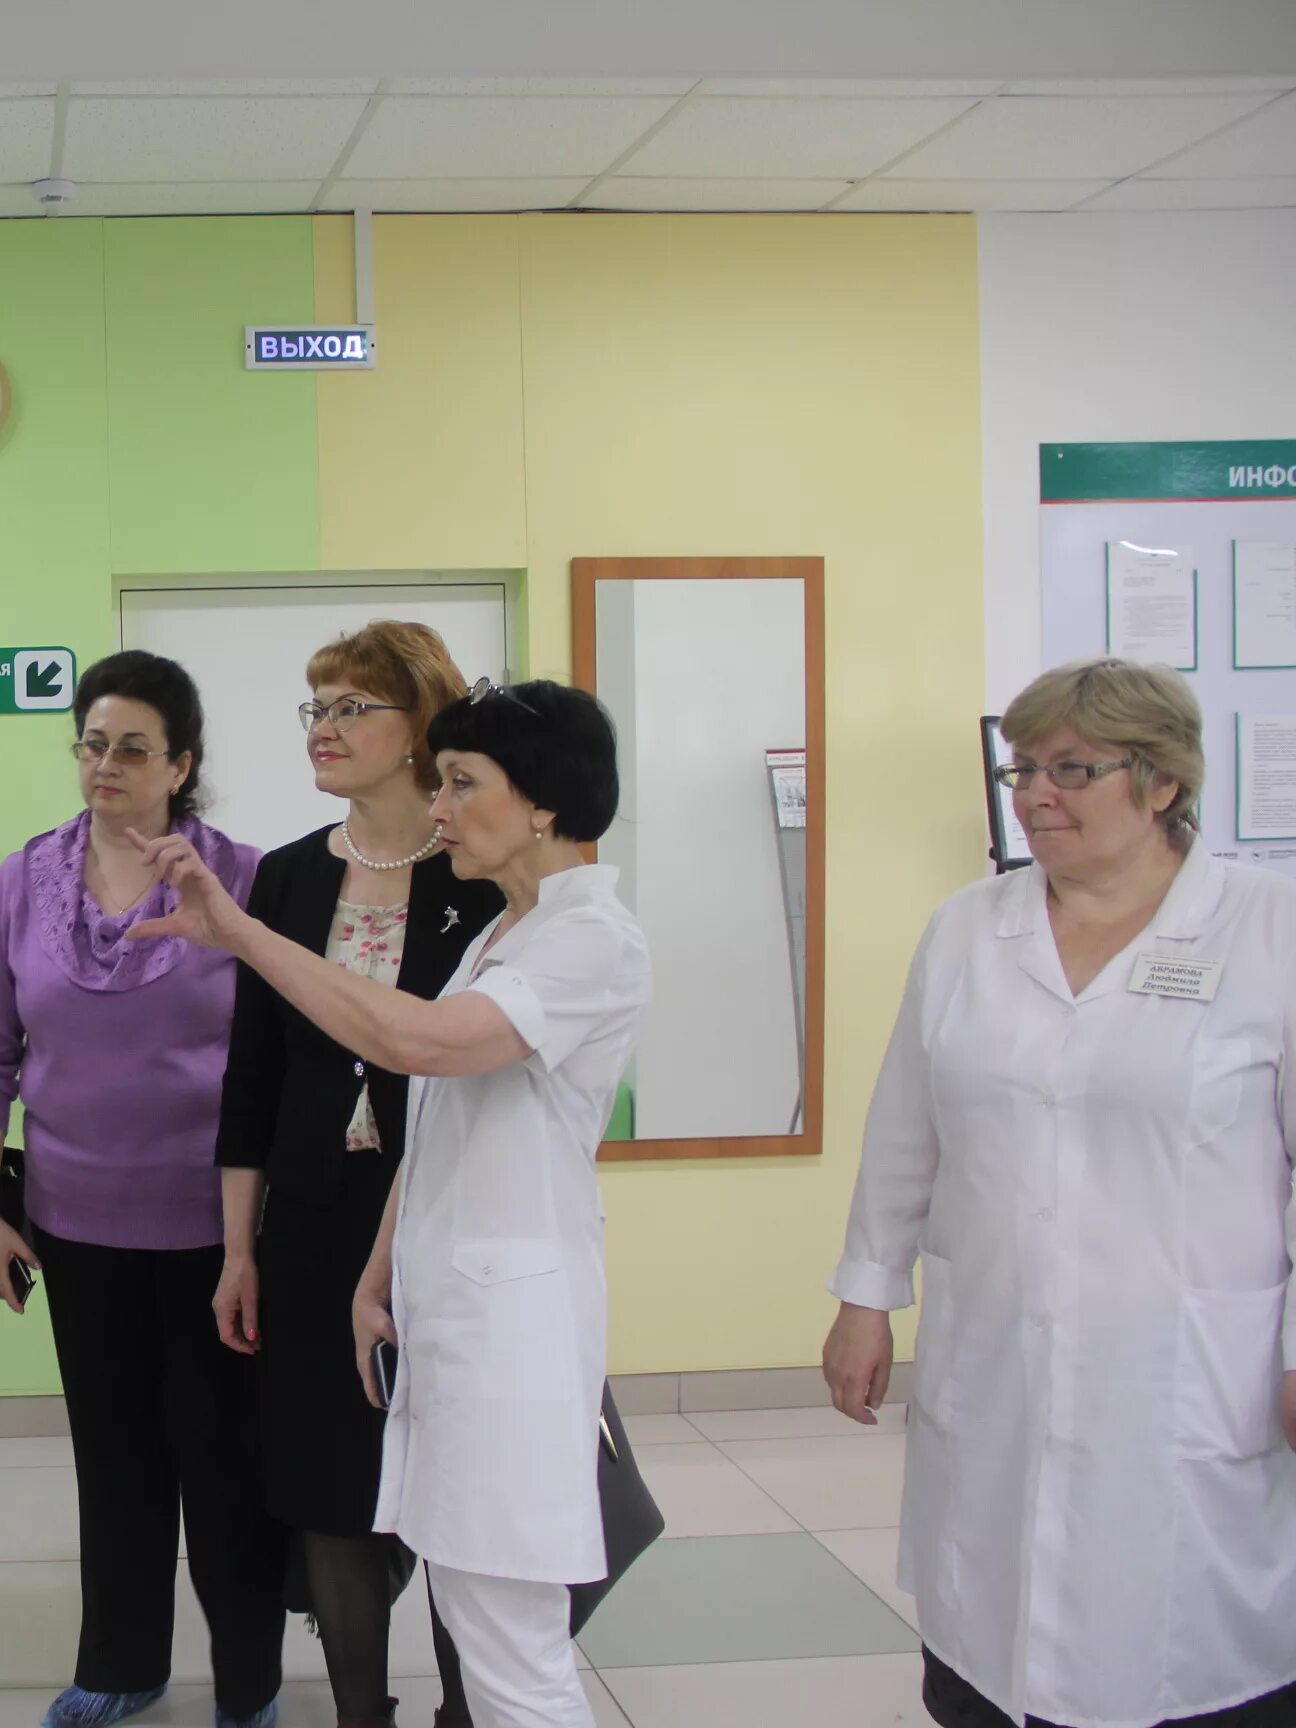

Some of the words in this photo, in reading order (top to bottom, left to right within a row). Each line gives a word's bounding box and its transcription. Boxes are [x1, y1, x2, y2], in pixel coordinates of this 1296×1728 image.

[261, 335, 364, 358] ВЫХОД
[1147, 973, 1201, 986] Людмила
[1142, 981, 1200, 995] Петровна
